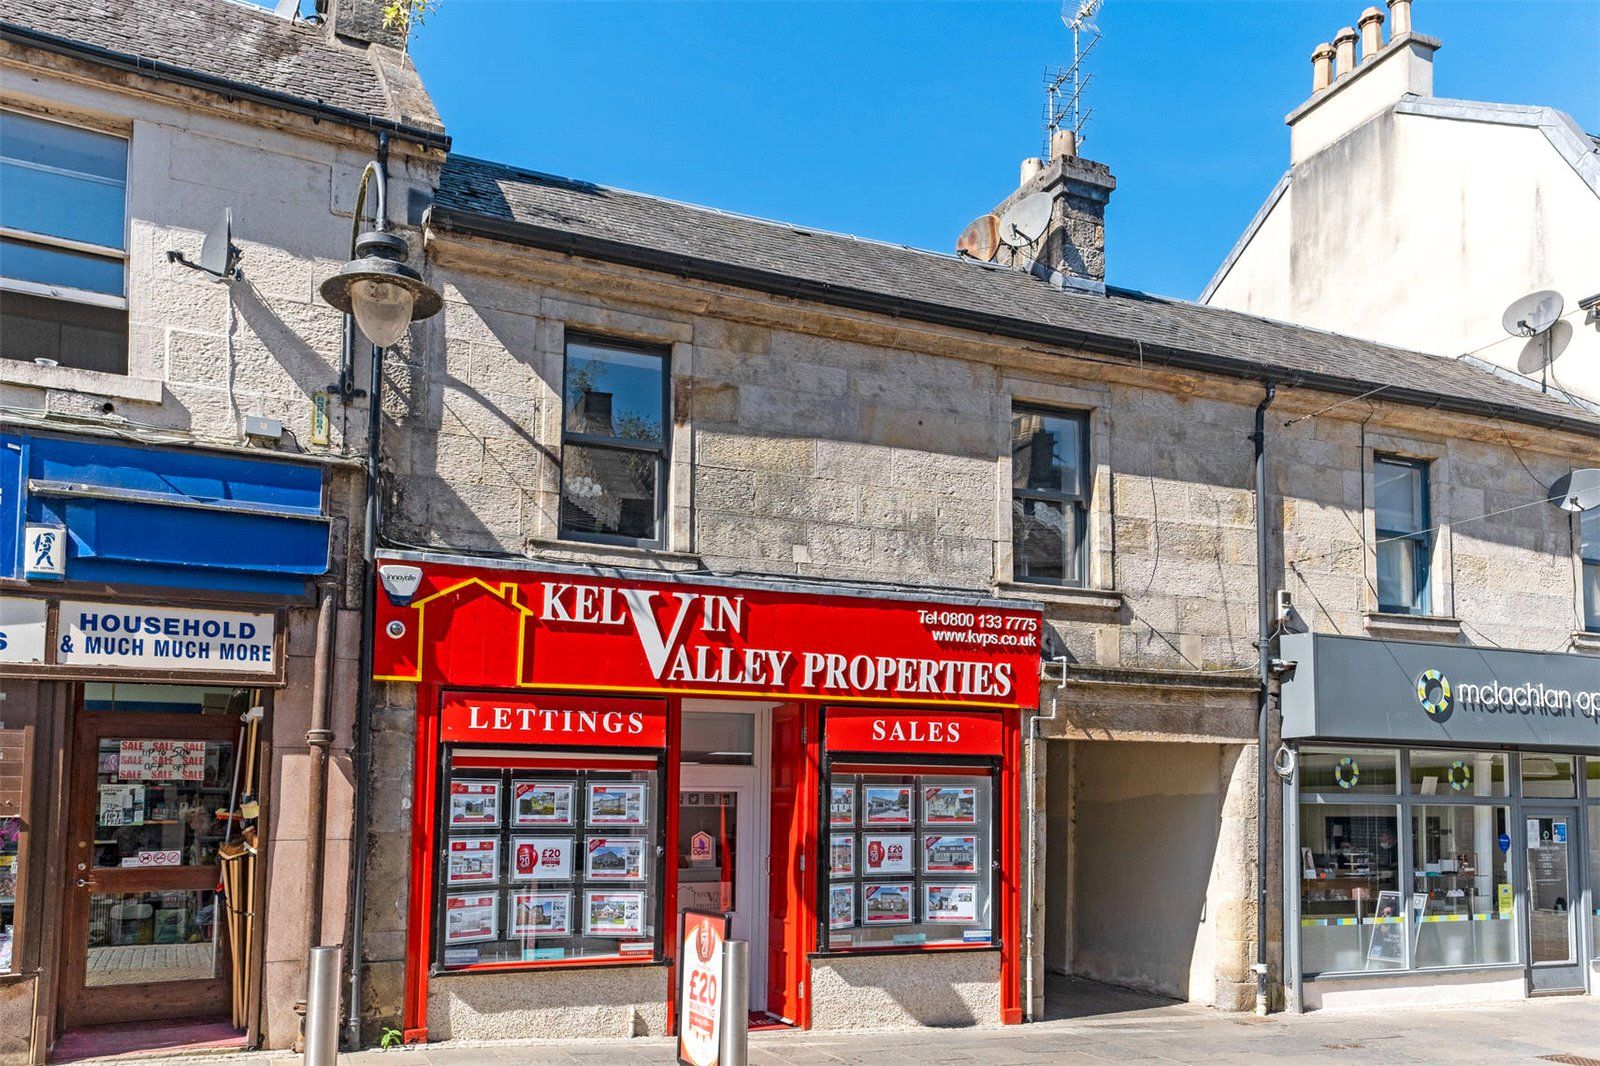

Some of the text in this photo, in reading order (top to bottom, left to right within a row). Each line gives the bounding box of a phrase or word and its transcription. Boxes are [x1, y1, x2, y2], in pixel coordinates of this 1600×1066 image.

[80, 613, 256, 640] HOUSEHOLD
[978, 614, 1002, 629] 133
[1005, 616, 1037, 631] 7775
[60, 635, 272, 662] & MUCH MUCH MORE
[932, 629, 1036, 647] www.kvps.co.uk
[801, 652, 1012, 697] PROPERTIES
[1458, 680, 1571, 708] mclachlan
[468, 706, 644, 735] LETTINGS
[872, 719, 960, 743] SALES
[121, 741, 204, 751] SALE SALE SALE
[120, 756, 204, 766] SALE SALE SALE
[119, 770, 203, 779] SALE SALE SALE
[542, 849, 560, 858] £20
[888, 845, 902, 853] £20
[689, 969, 717, 1006] £20
